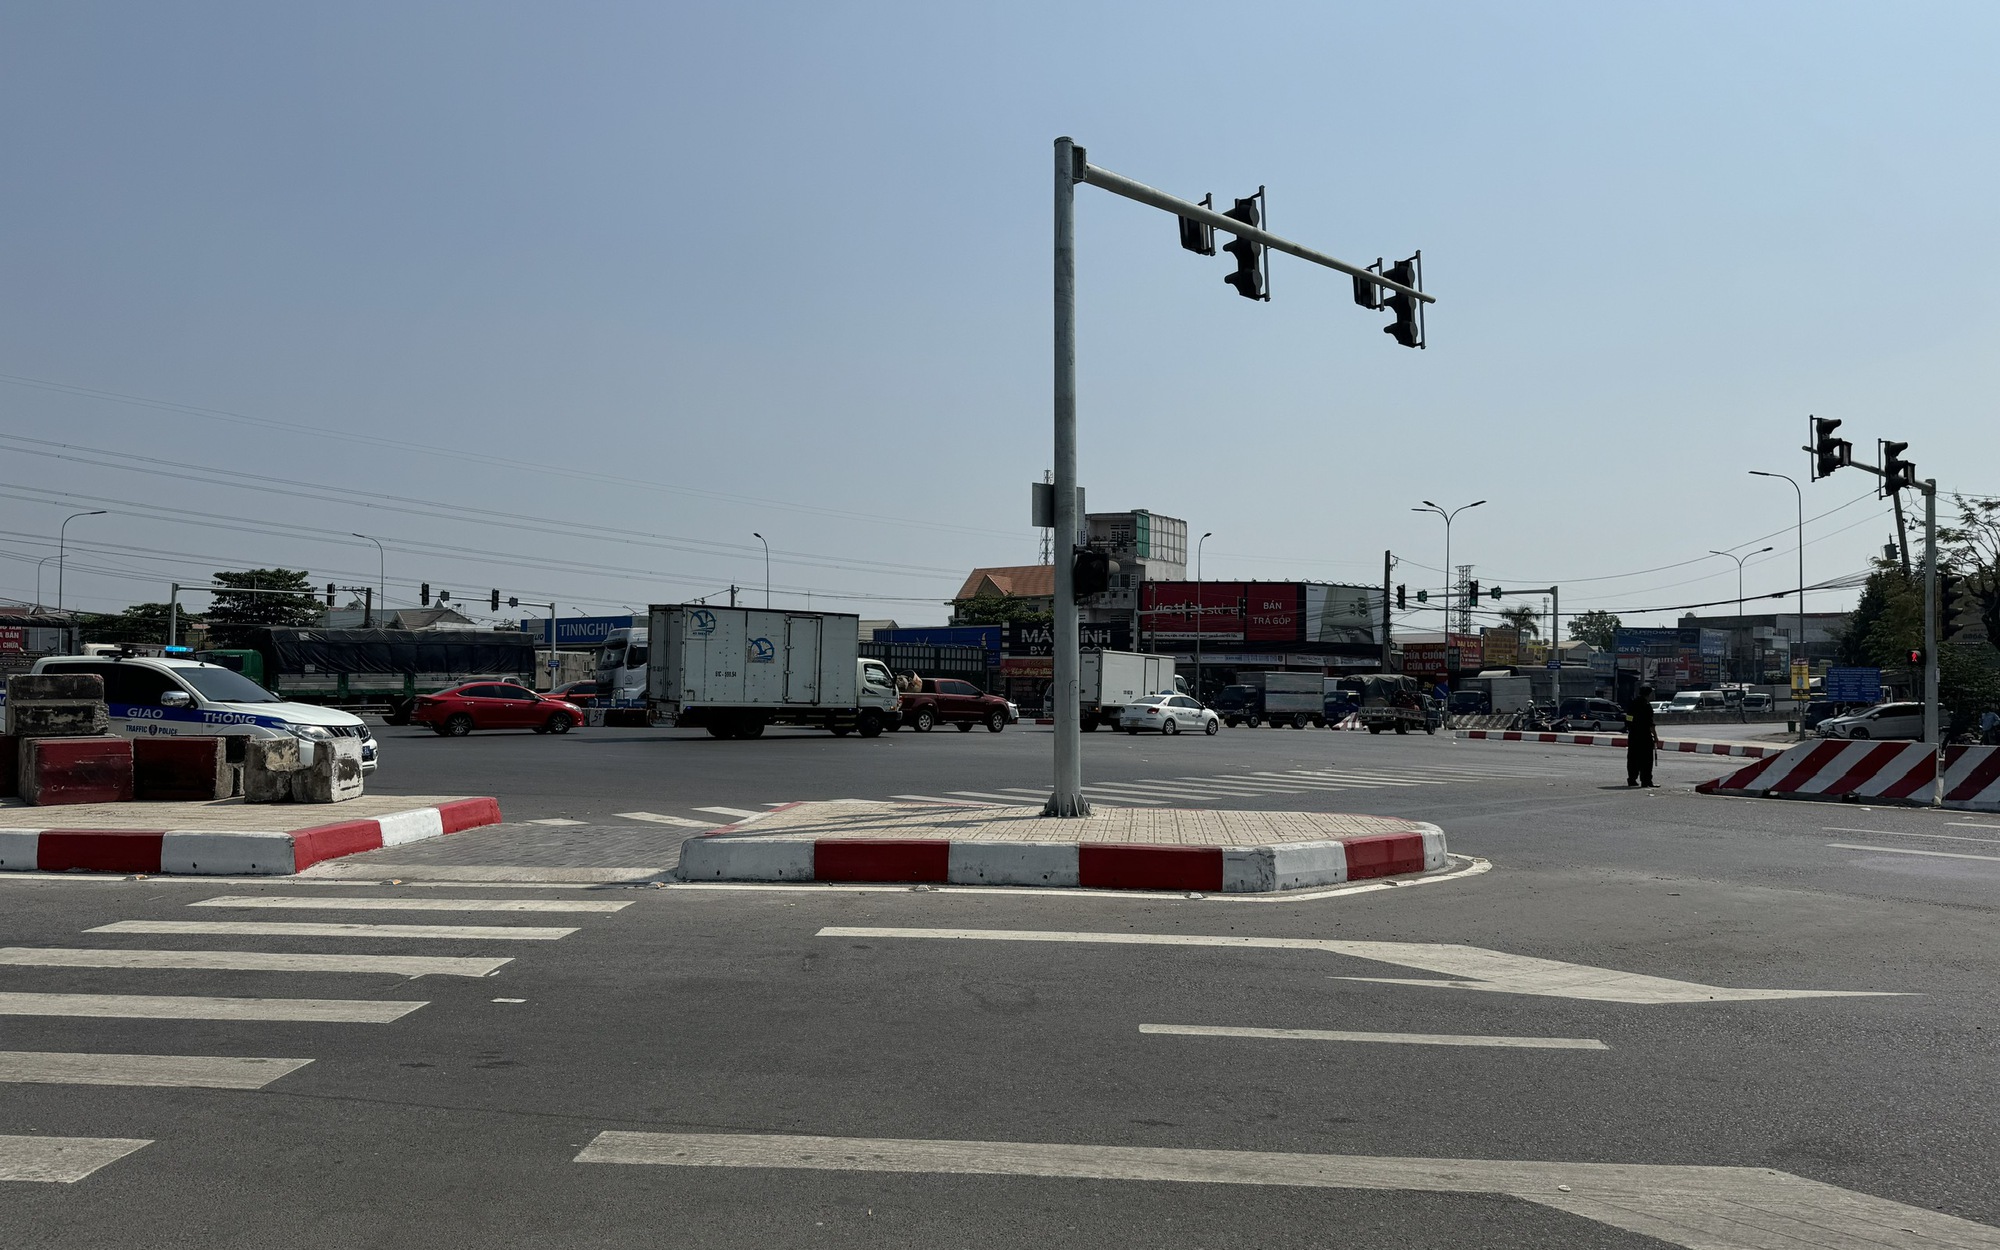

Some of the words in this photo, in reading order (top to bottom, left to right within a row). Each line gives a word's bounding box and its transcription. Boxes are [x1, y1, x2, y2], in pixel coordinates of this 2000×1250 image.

[1263, 599, 1282, 609] BÁN
[1252, 614, 1271, 625] TRẢ
[1272, 614, 1291, 625] GÓP
[1021, 622, 1054, 643] MẮ
[1080, 625, 1111, 644] ÍNH
[1030, 645, 1047, 656] BV
[1403, 649, 1420, 660] CỬA
[1406, 660, 1423, 671] CỬA
[127, 707, 164, 719] GIAO
[203, 709, 257, 724] THÔNG
[125, 724, 148, 733] TRAFFIC
[158, 727, 178, 735] POLICE
